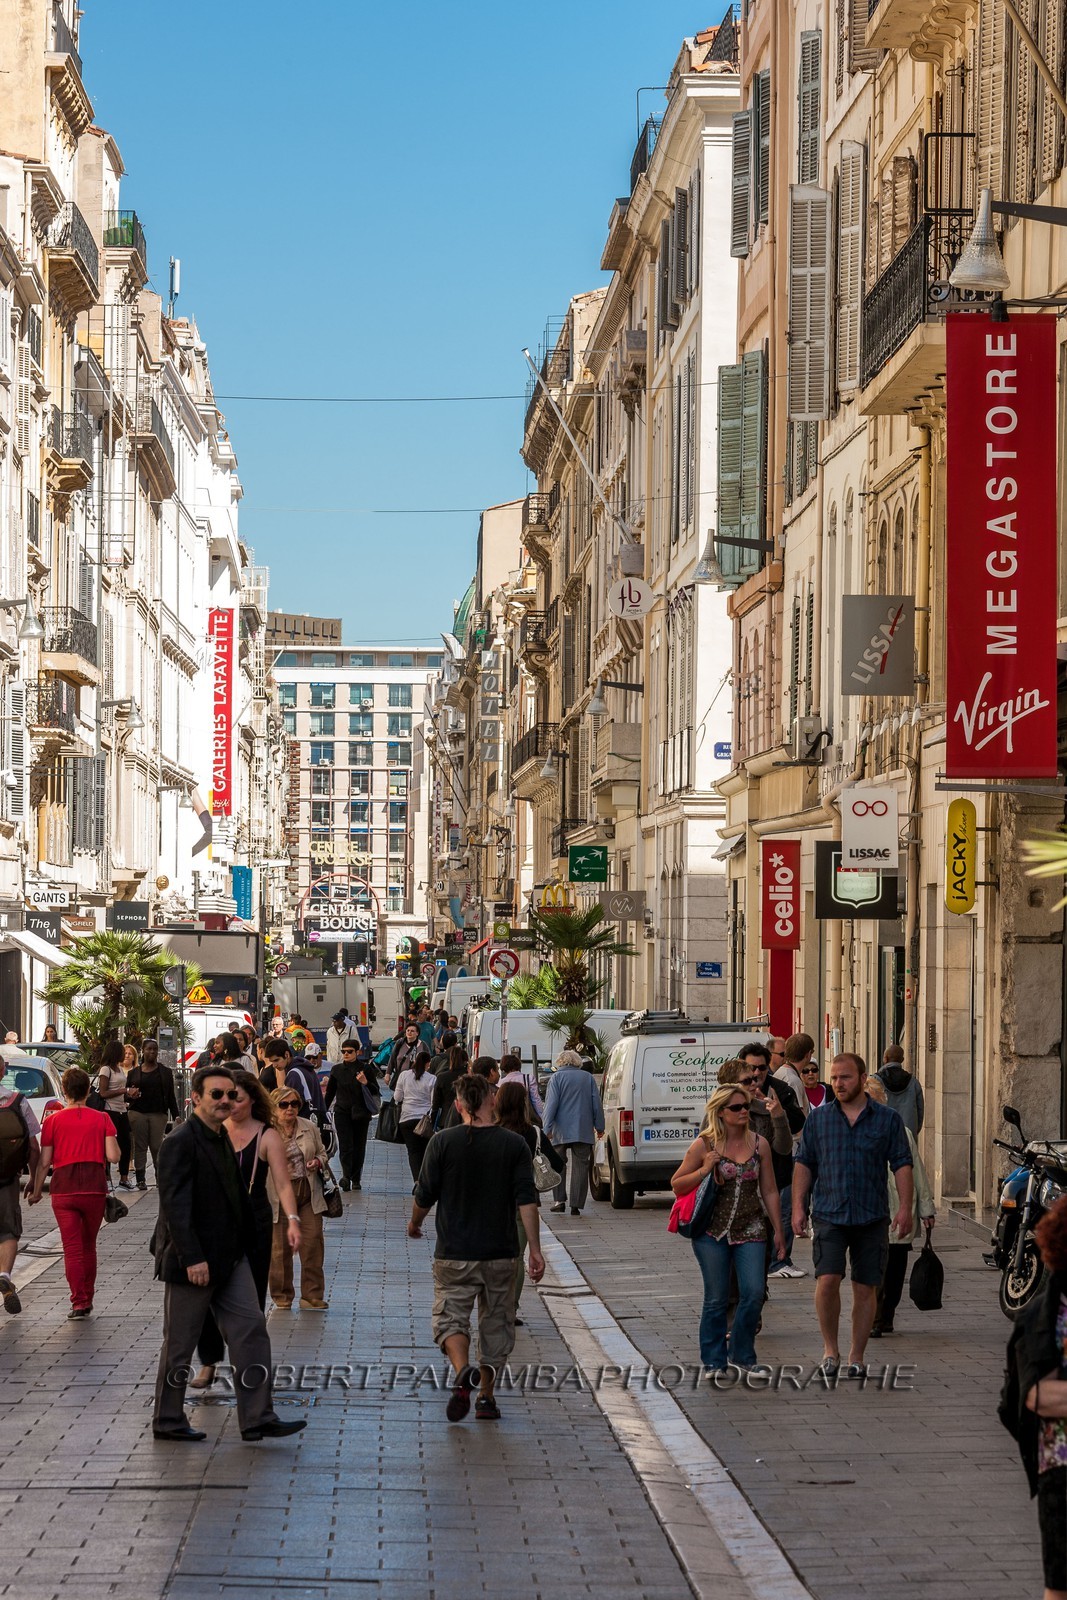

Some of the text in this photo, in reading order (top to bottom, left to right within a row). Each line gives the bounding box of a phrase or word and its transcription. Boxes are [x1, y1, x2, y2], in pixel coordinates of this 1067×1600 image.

[985, 333, 1018, 655] MEGASTORE
[850, 606, 907, 685] LISSAC
[213, 615, 228, 704] LAFAYETTE
[482, 653, 498, 760] HOTEL
[953, 671, 1050, 754] Virgin
[212, 713, 227, 793] GALERIES
[849, 848, 890, 859] LISSAC
[33, 892, 66, 903] GANTS
[310, 903, 365, 916] CENTRE
[29, 919, 51, 929] The
[320, 916, 378, 931] BOURSE
[46, 929, 57, 938] M
[686, 1085, 718, 1093] 06.78.7
[650, 1128, 693, 1138] BX-628-FC
